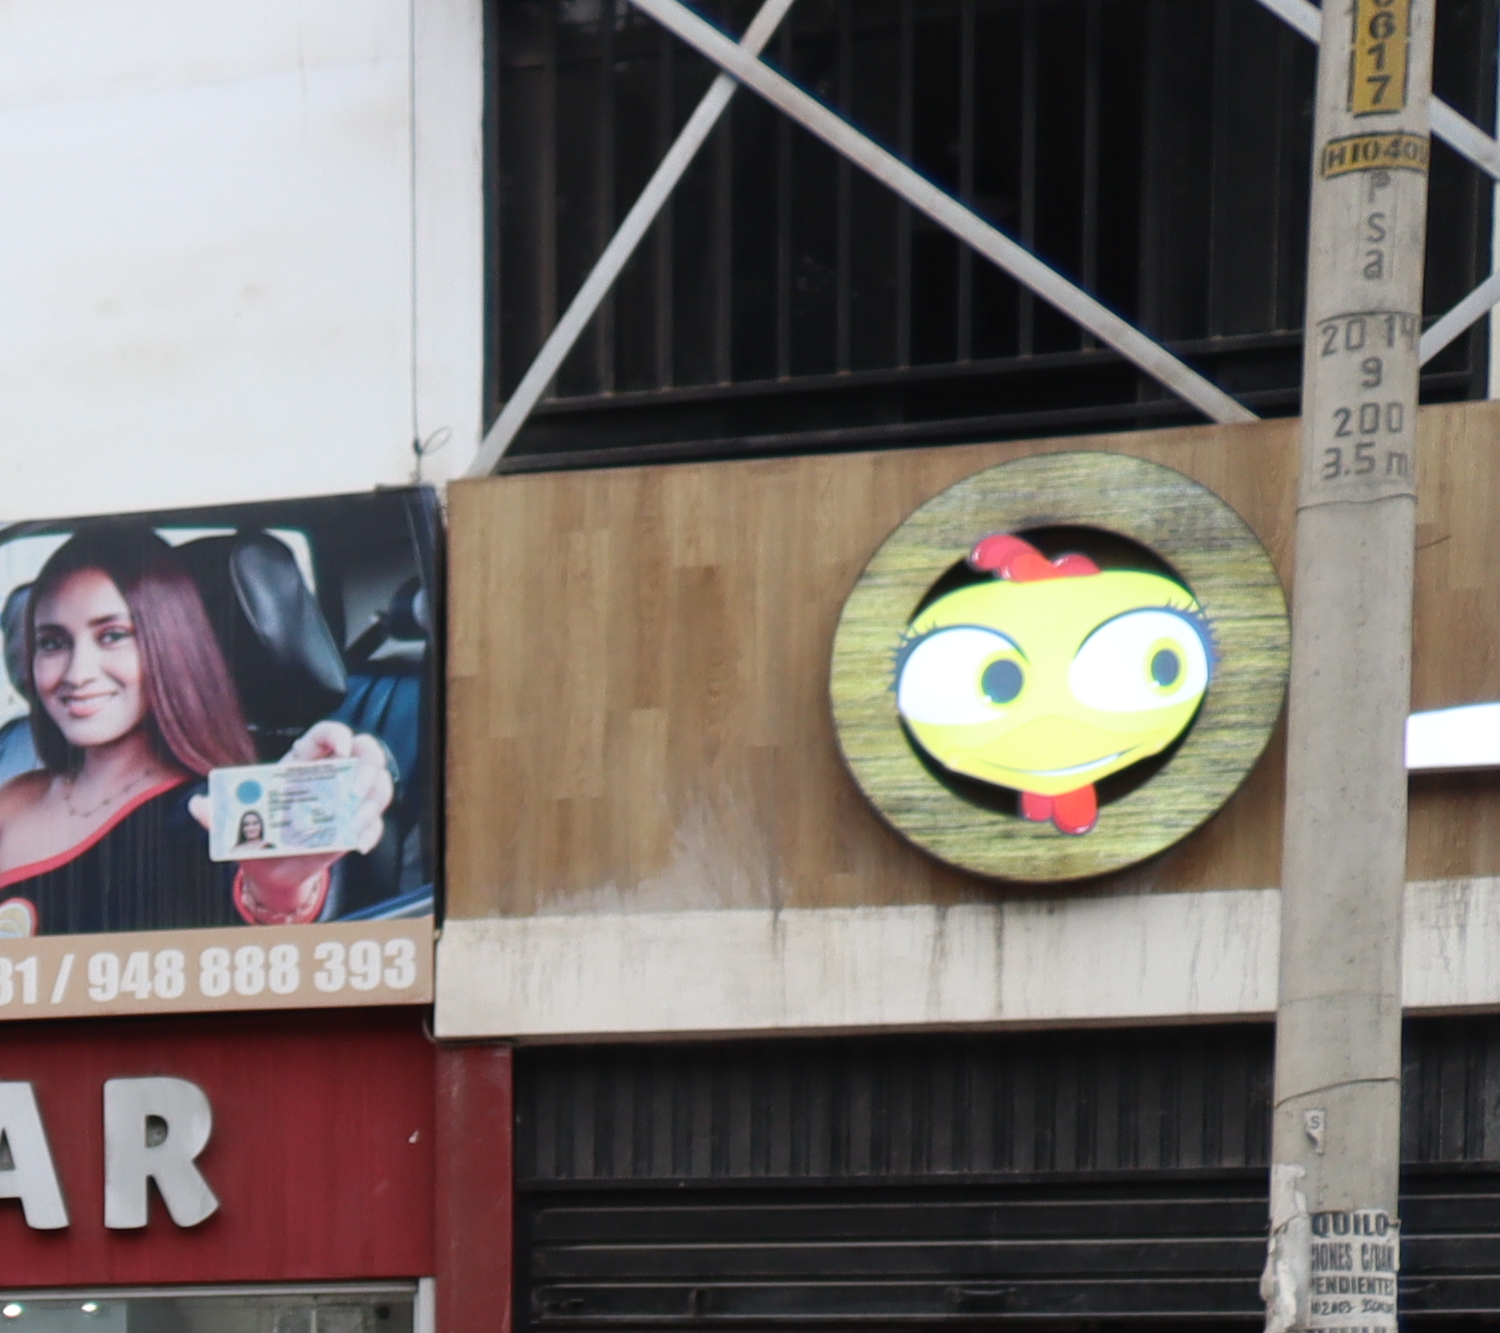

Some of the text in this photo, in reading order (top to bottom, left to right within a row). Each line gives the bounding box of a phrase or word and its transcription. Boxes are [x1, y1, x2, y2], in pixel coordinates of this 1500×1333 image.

[1366, 0, 1395, 105] 617
[1332, 402, 1404, 438] 200
[50, 950, 73, 1003] /
[88, 951, 185, 1002] 948
[198, 944, 301, 997] 888
[313, 937, 417, 993] 393
